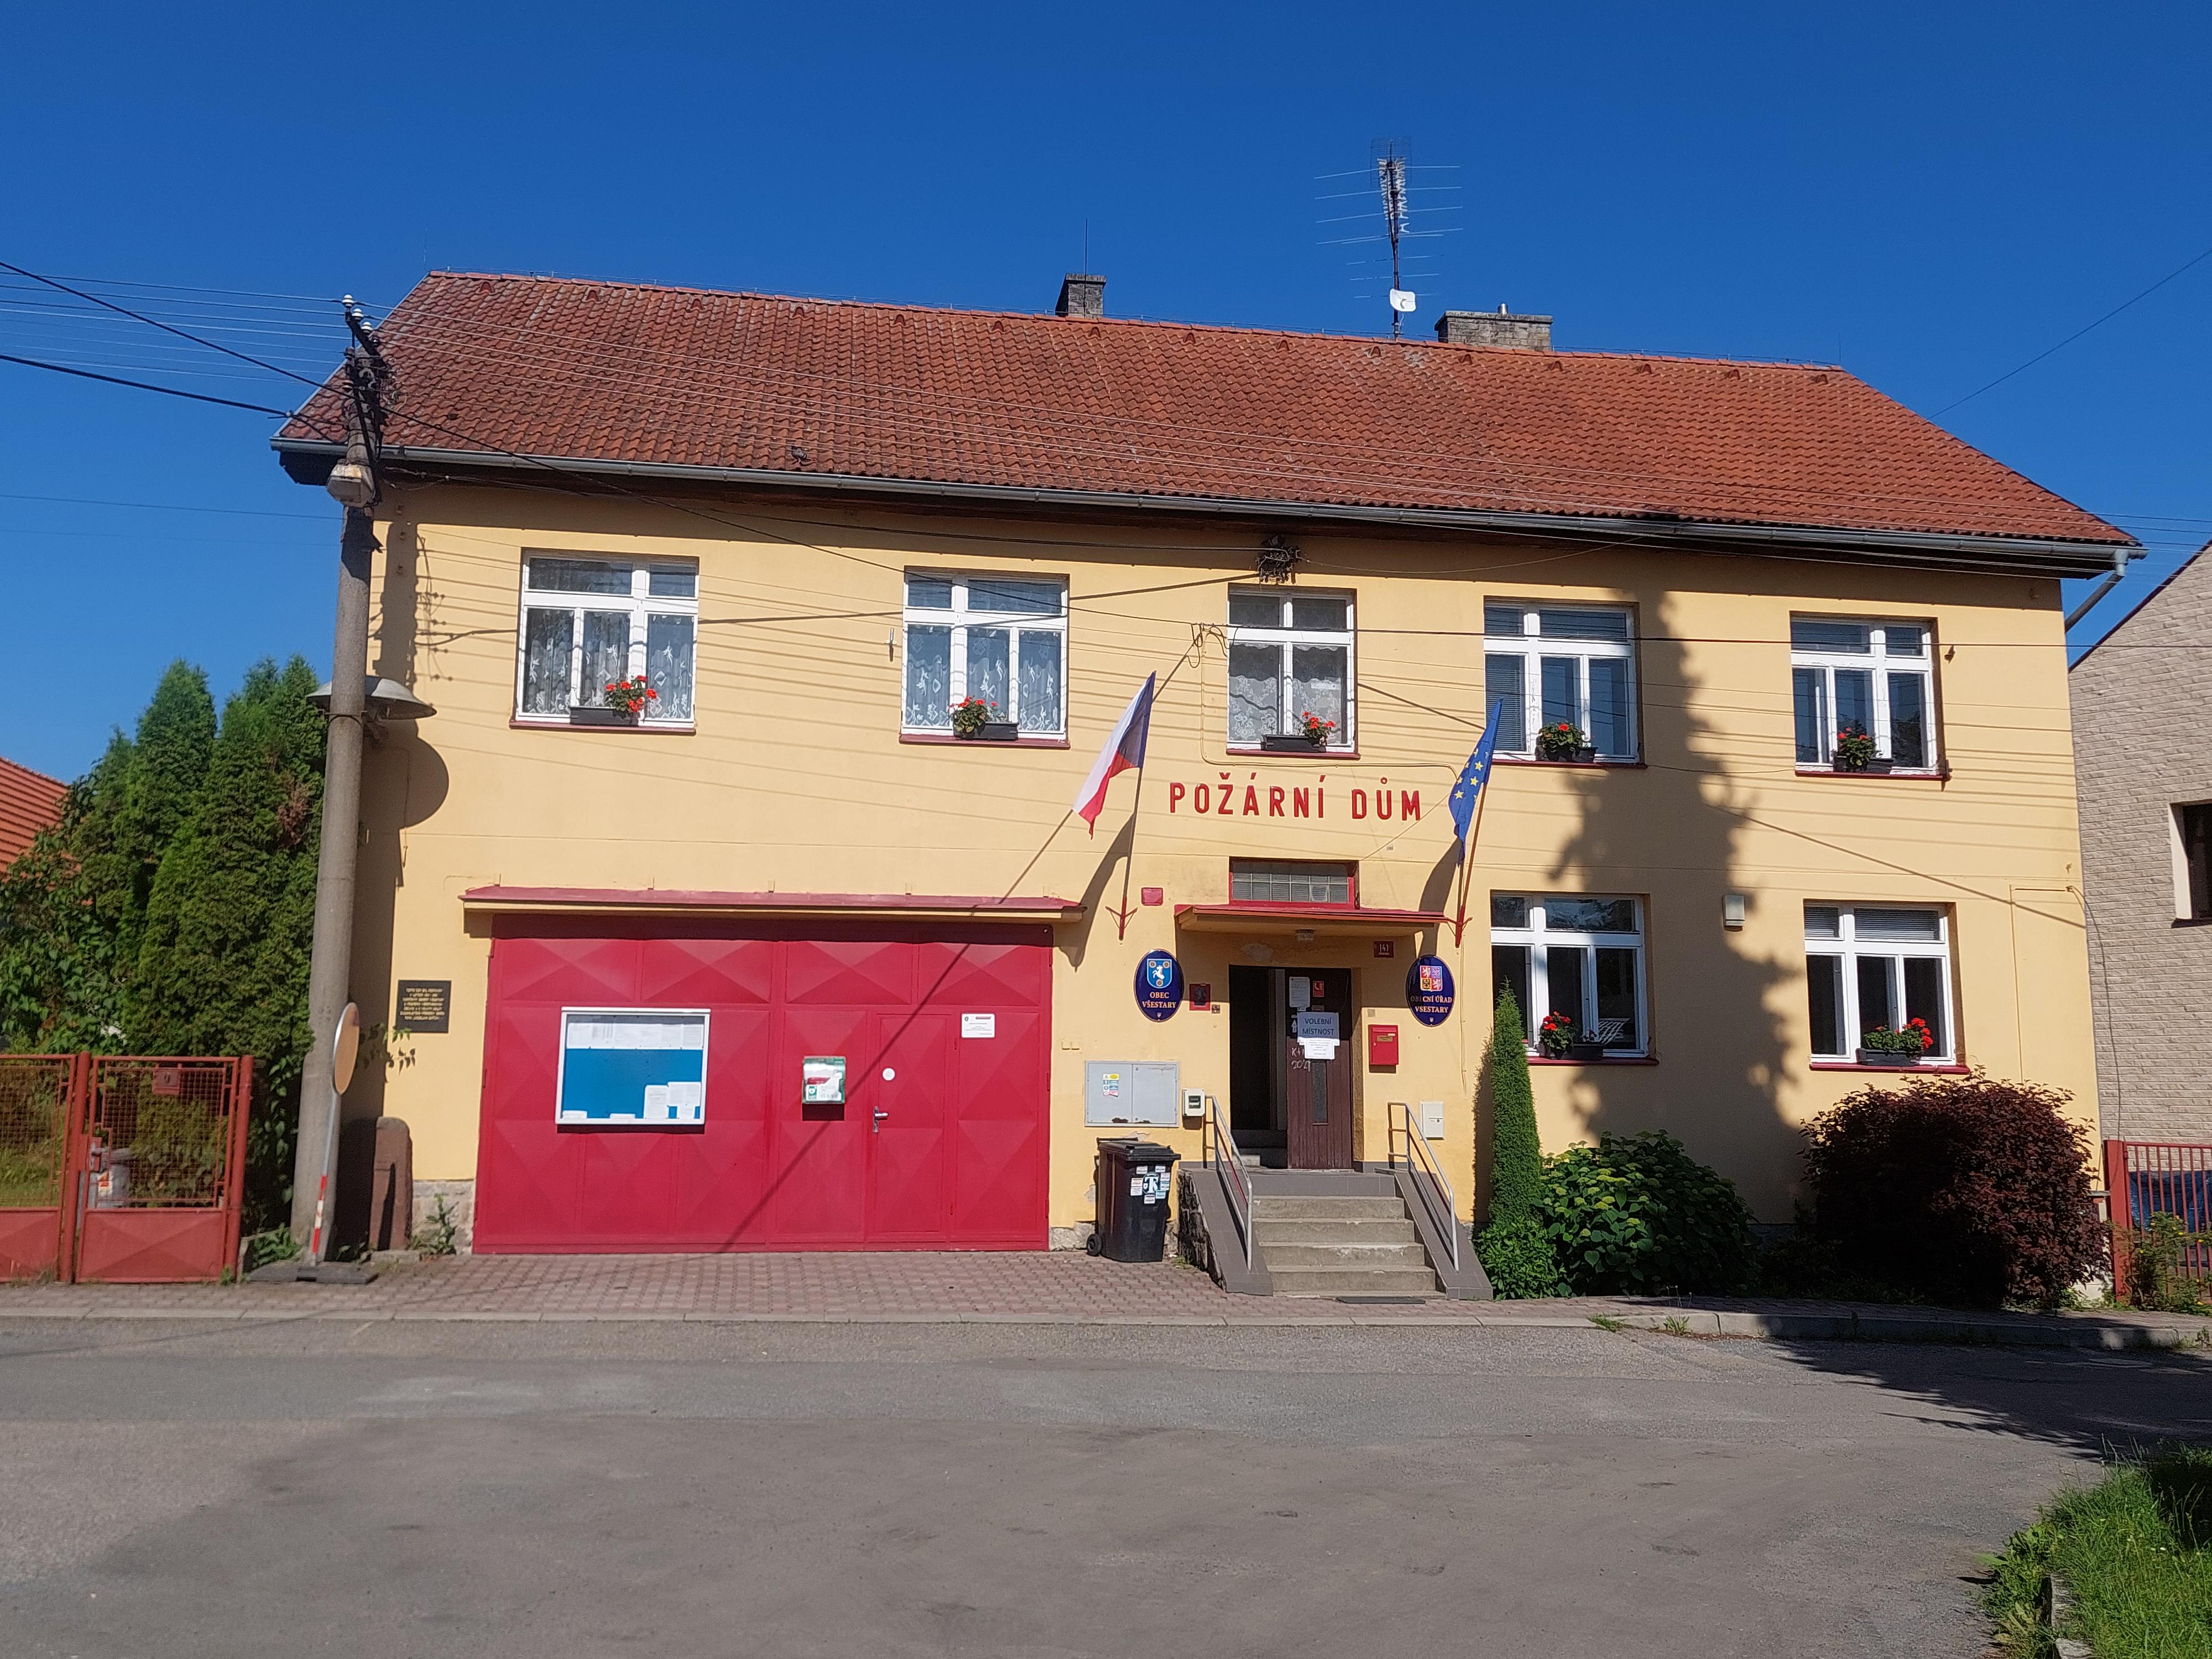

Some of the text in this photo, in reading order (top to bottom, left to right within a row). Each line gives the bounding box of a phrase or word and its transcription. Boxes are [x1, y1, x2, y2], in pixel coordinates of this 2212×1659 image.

[1169, 771, 1422, 821] POŽÁRNÍ DŮM
[1142, 1000, 1176, 1008] VŠESTARY
[1302, 1027, 1335, 1036] MÍSTNOST
